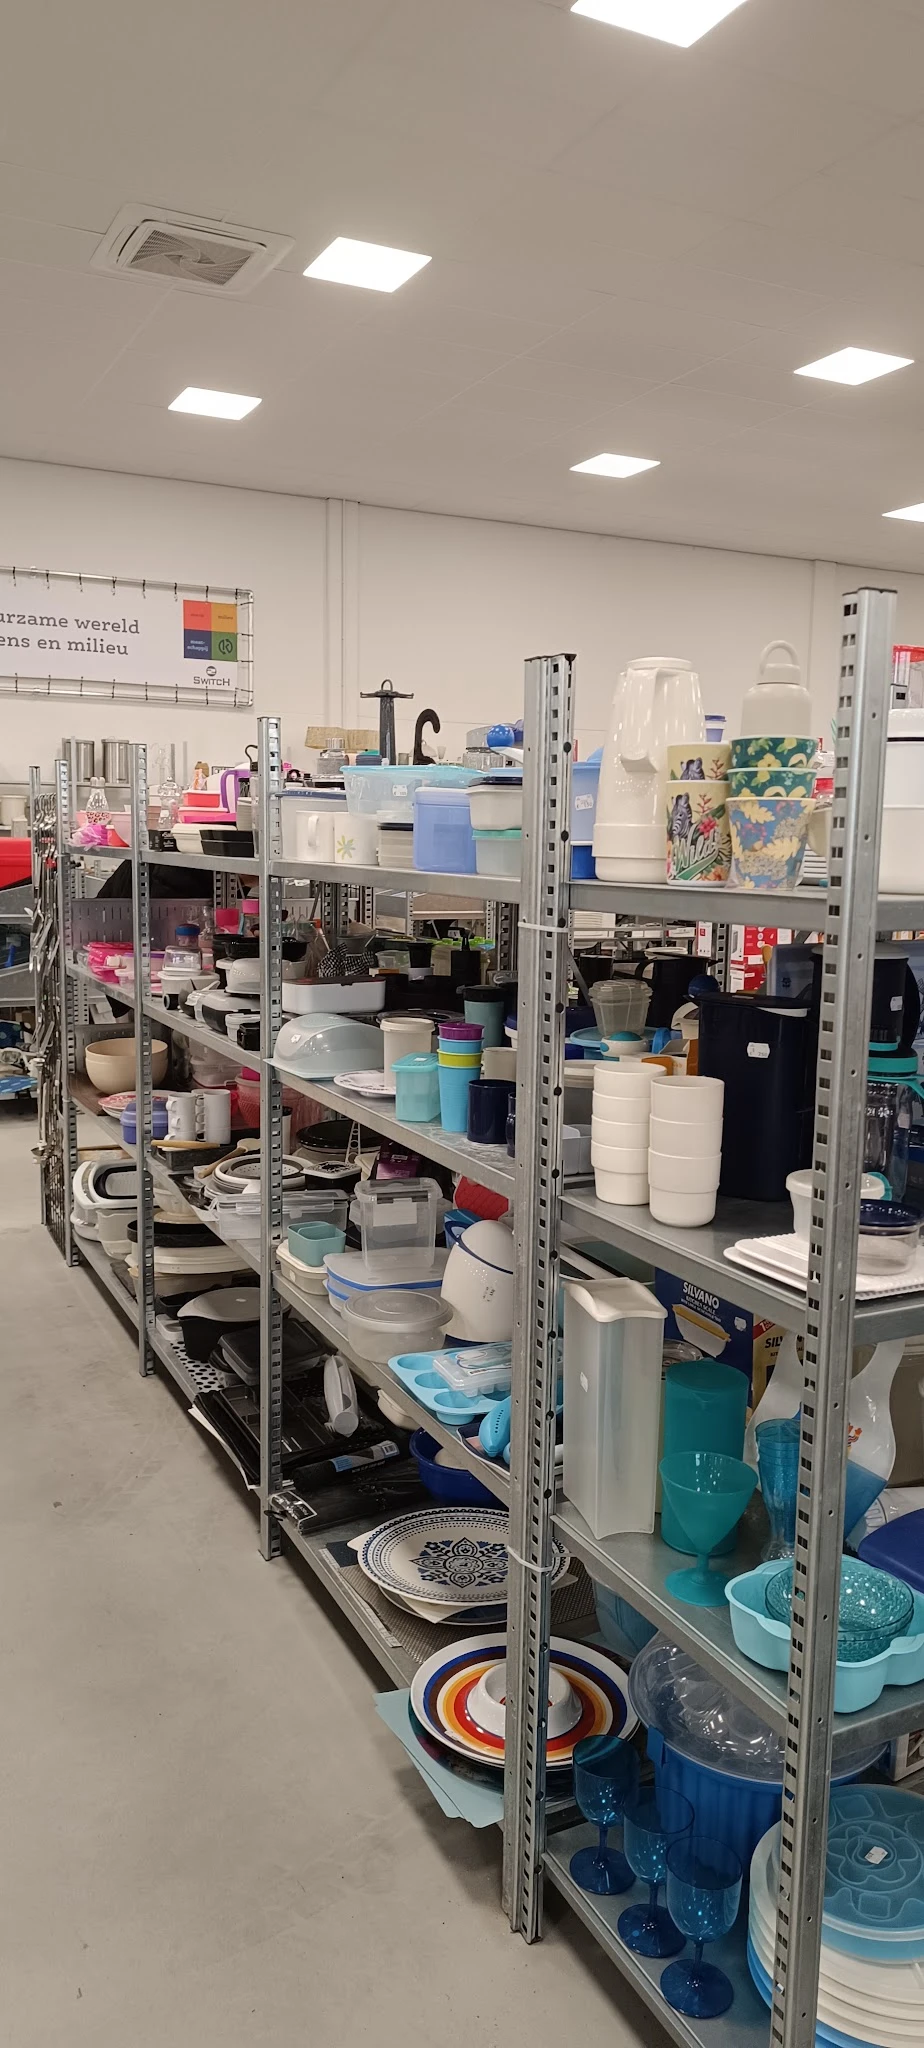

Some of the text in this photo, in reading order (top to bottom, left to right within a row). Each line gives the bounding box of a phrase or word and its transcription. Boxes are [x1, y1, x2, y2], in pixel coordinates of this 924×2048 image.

[75, 618, 140, 635] wereld
[37, 638, 61, 650] en
[67, 637, 128, 656] milieu
[682, 1281, 720, 1310] SILVANO
